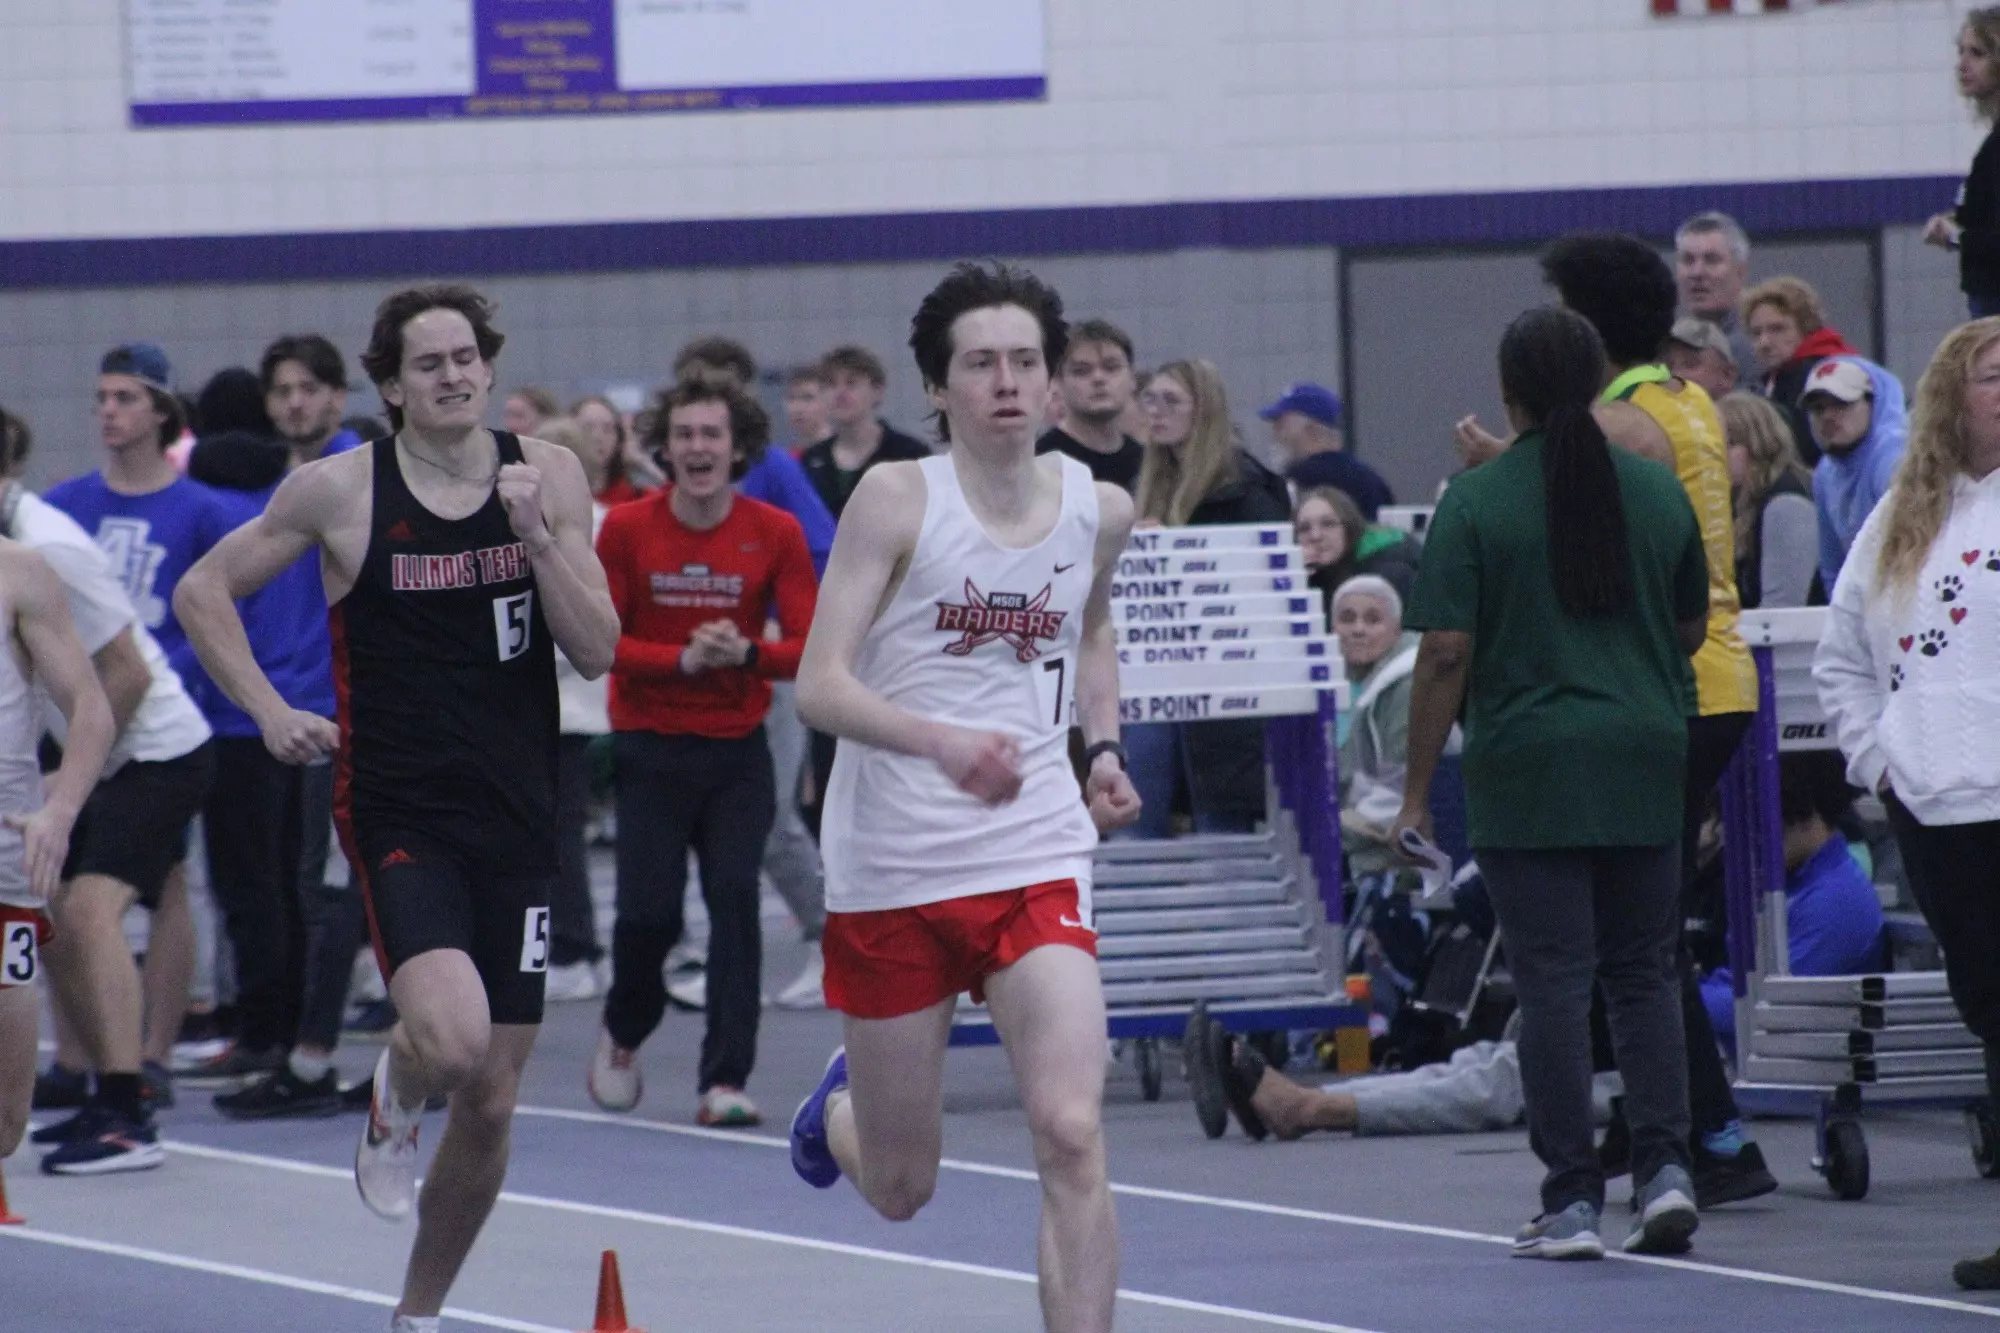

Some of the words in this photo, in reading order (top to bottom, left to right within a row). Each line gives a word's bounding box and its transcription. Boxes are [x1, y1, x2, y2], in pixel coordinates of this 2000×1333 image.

[392, 552, 476, 591] ILLINOIS
[477, 542, 530, 585] TECH
[1121, 556, 1169, 577] OINT
[991, 594, 1023, 609] MSOE
[1111, 580, 1182, 599] POINT
[507, 597, 527, 655] 5
[942, 604, 1063, 636] RAIDERS
[1125, 602, 1187, 621] POINT
[1127, 625, 1201, 644] POINT
[1043, 657, 1064, 726] 7
[1150, 694, 1212, 720] POINT
[8, 926, 34, 981] 3
[532, 911, 548, 968] 5
